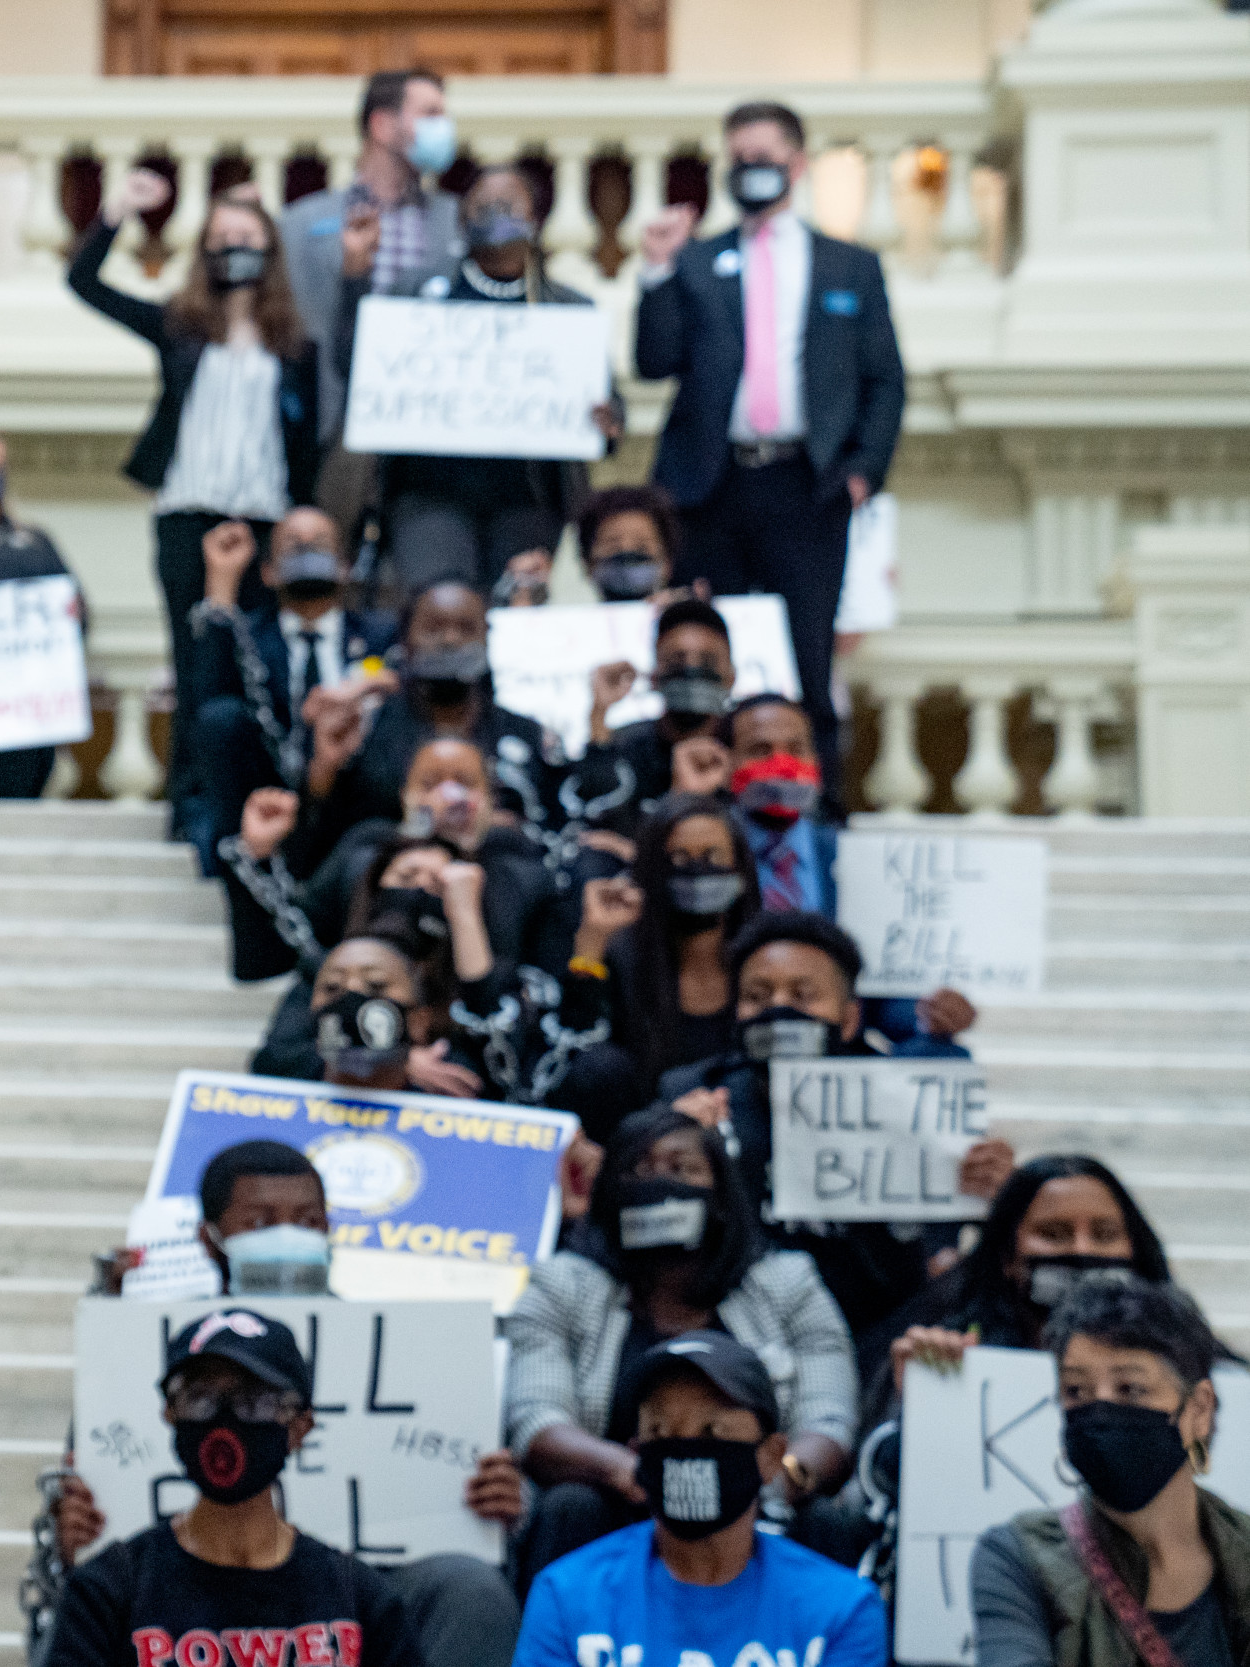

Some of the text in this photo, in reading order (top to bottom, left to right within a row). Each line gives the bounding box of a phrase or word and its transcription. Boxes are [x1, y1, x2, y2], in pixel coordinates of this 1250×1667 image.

[376, 347, 560, 388] VOTER
[882, 836, 987, 883] KILL
[902, 879, 952, 922] THE
[880, 920, 974, 973] BILL
[190, 1085, 557, 1152] Show Your POWER!
[789, 1071, 987, 1136] KILL THE
[814, 1147, 953, 1204] BILL
